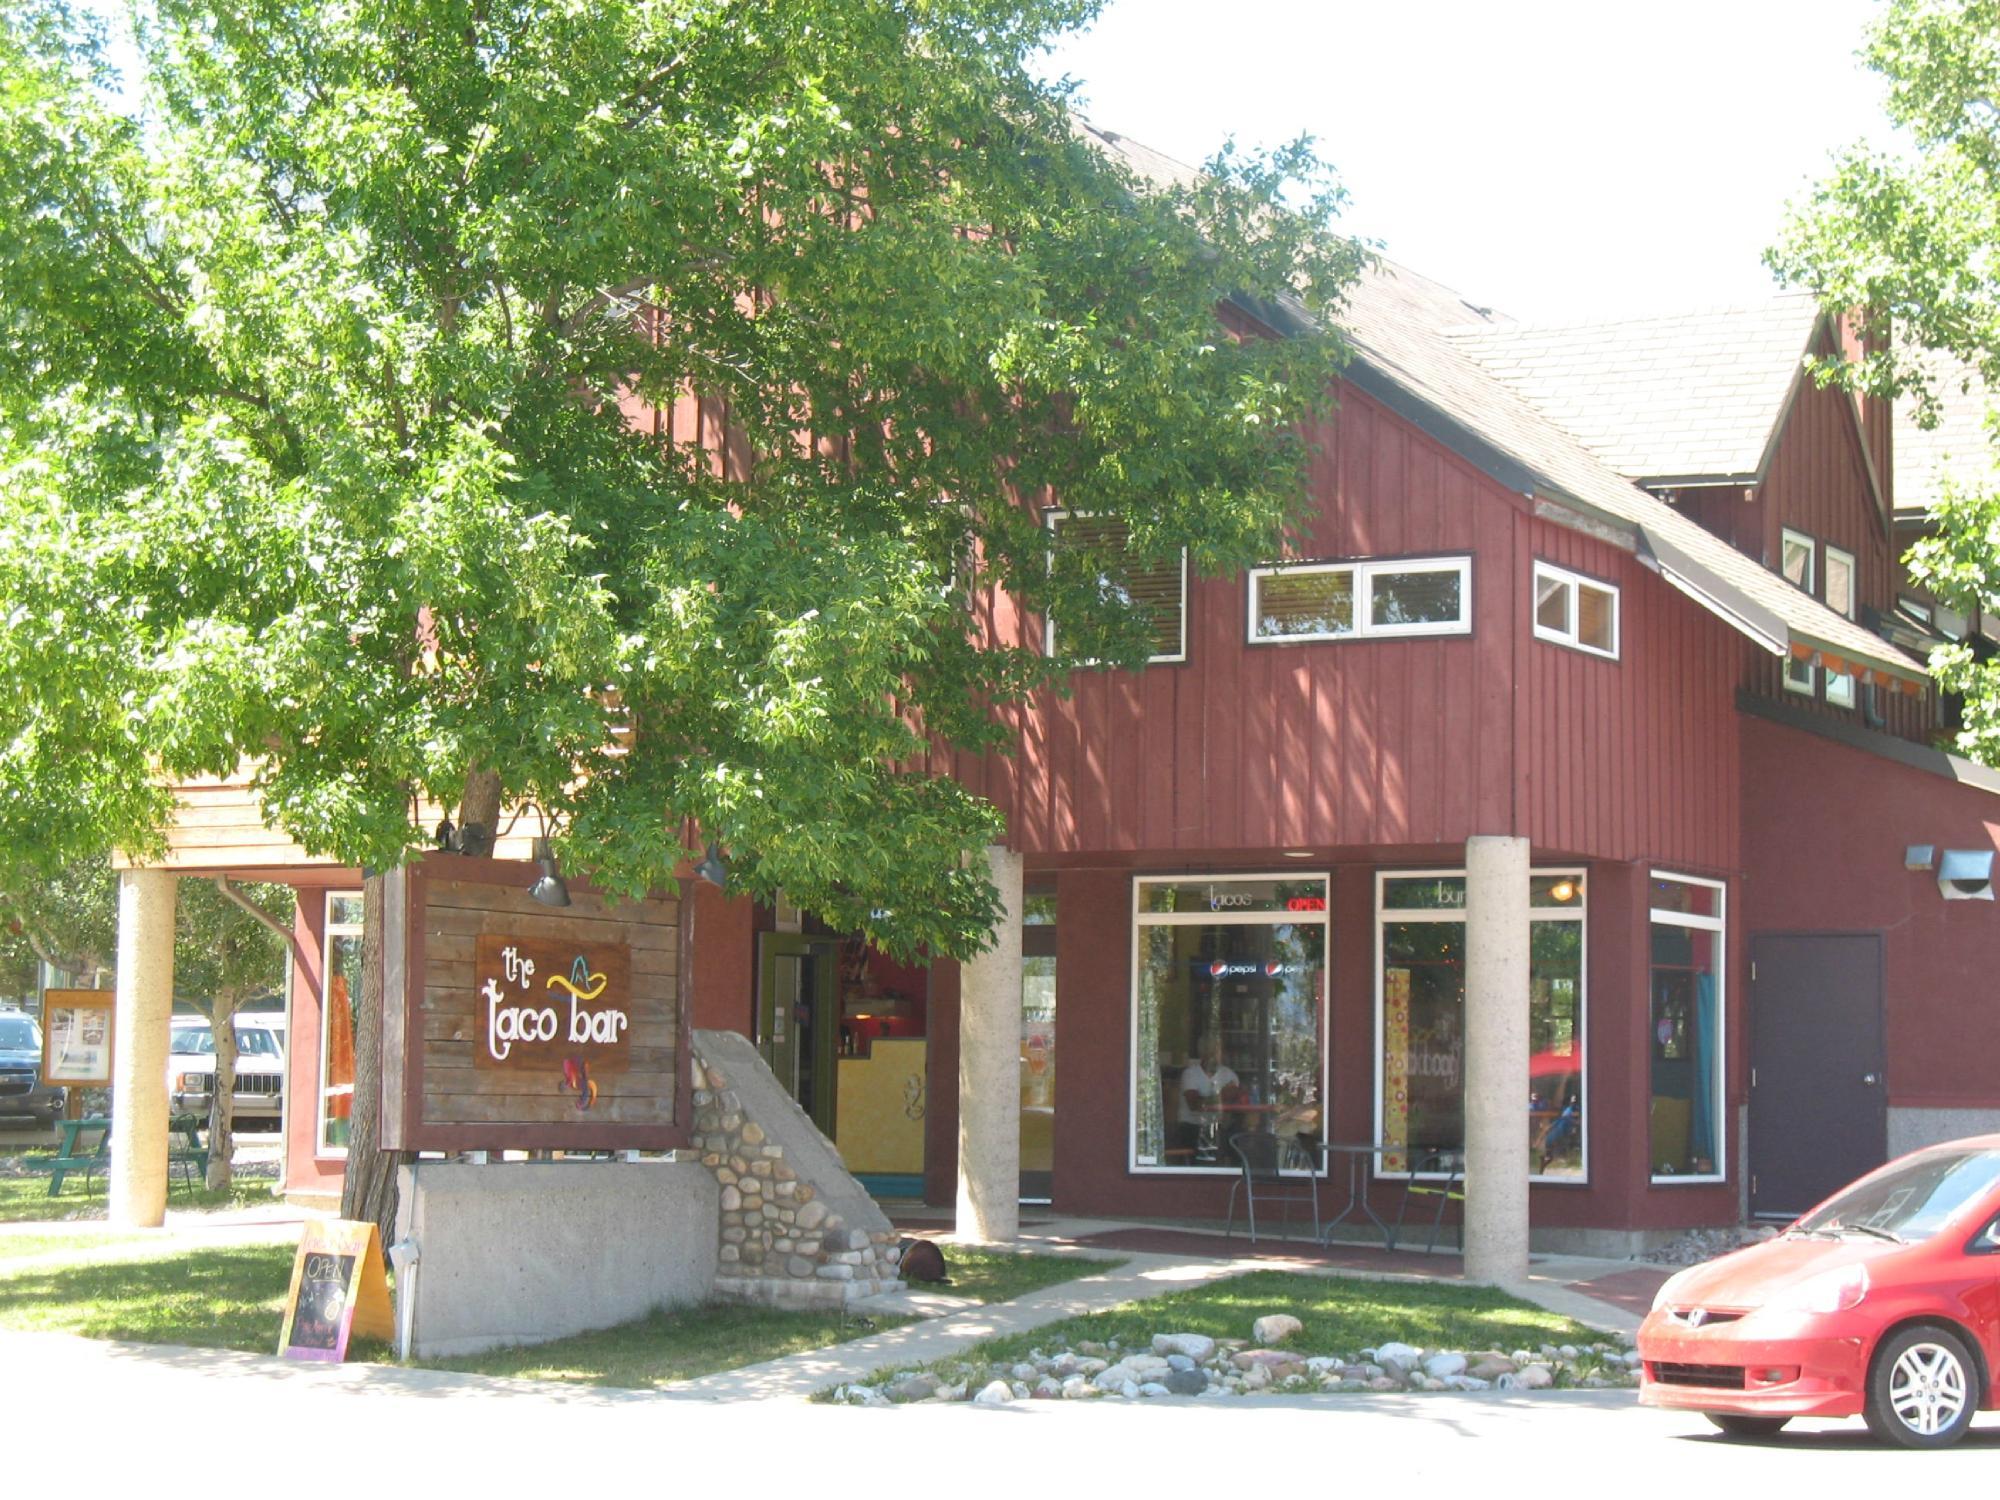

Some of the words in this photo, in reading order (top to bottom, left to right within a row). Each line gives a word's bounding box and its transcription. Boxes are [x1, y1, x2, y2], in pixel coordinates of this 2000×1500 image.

[1209, 884, 1253, 911] tacos
[1286, 897, 1326, 912] OPEN
[502, 946, 535, 989] the
[1228, 963, 1257, 975] pepsi
[481, 977, 558, 1060] taco
[568, 991, 628, 1044] bar
